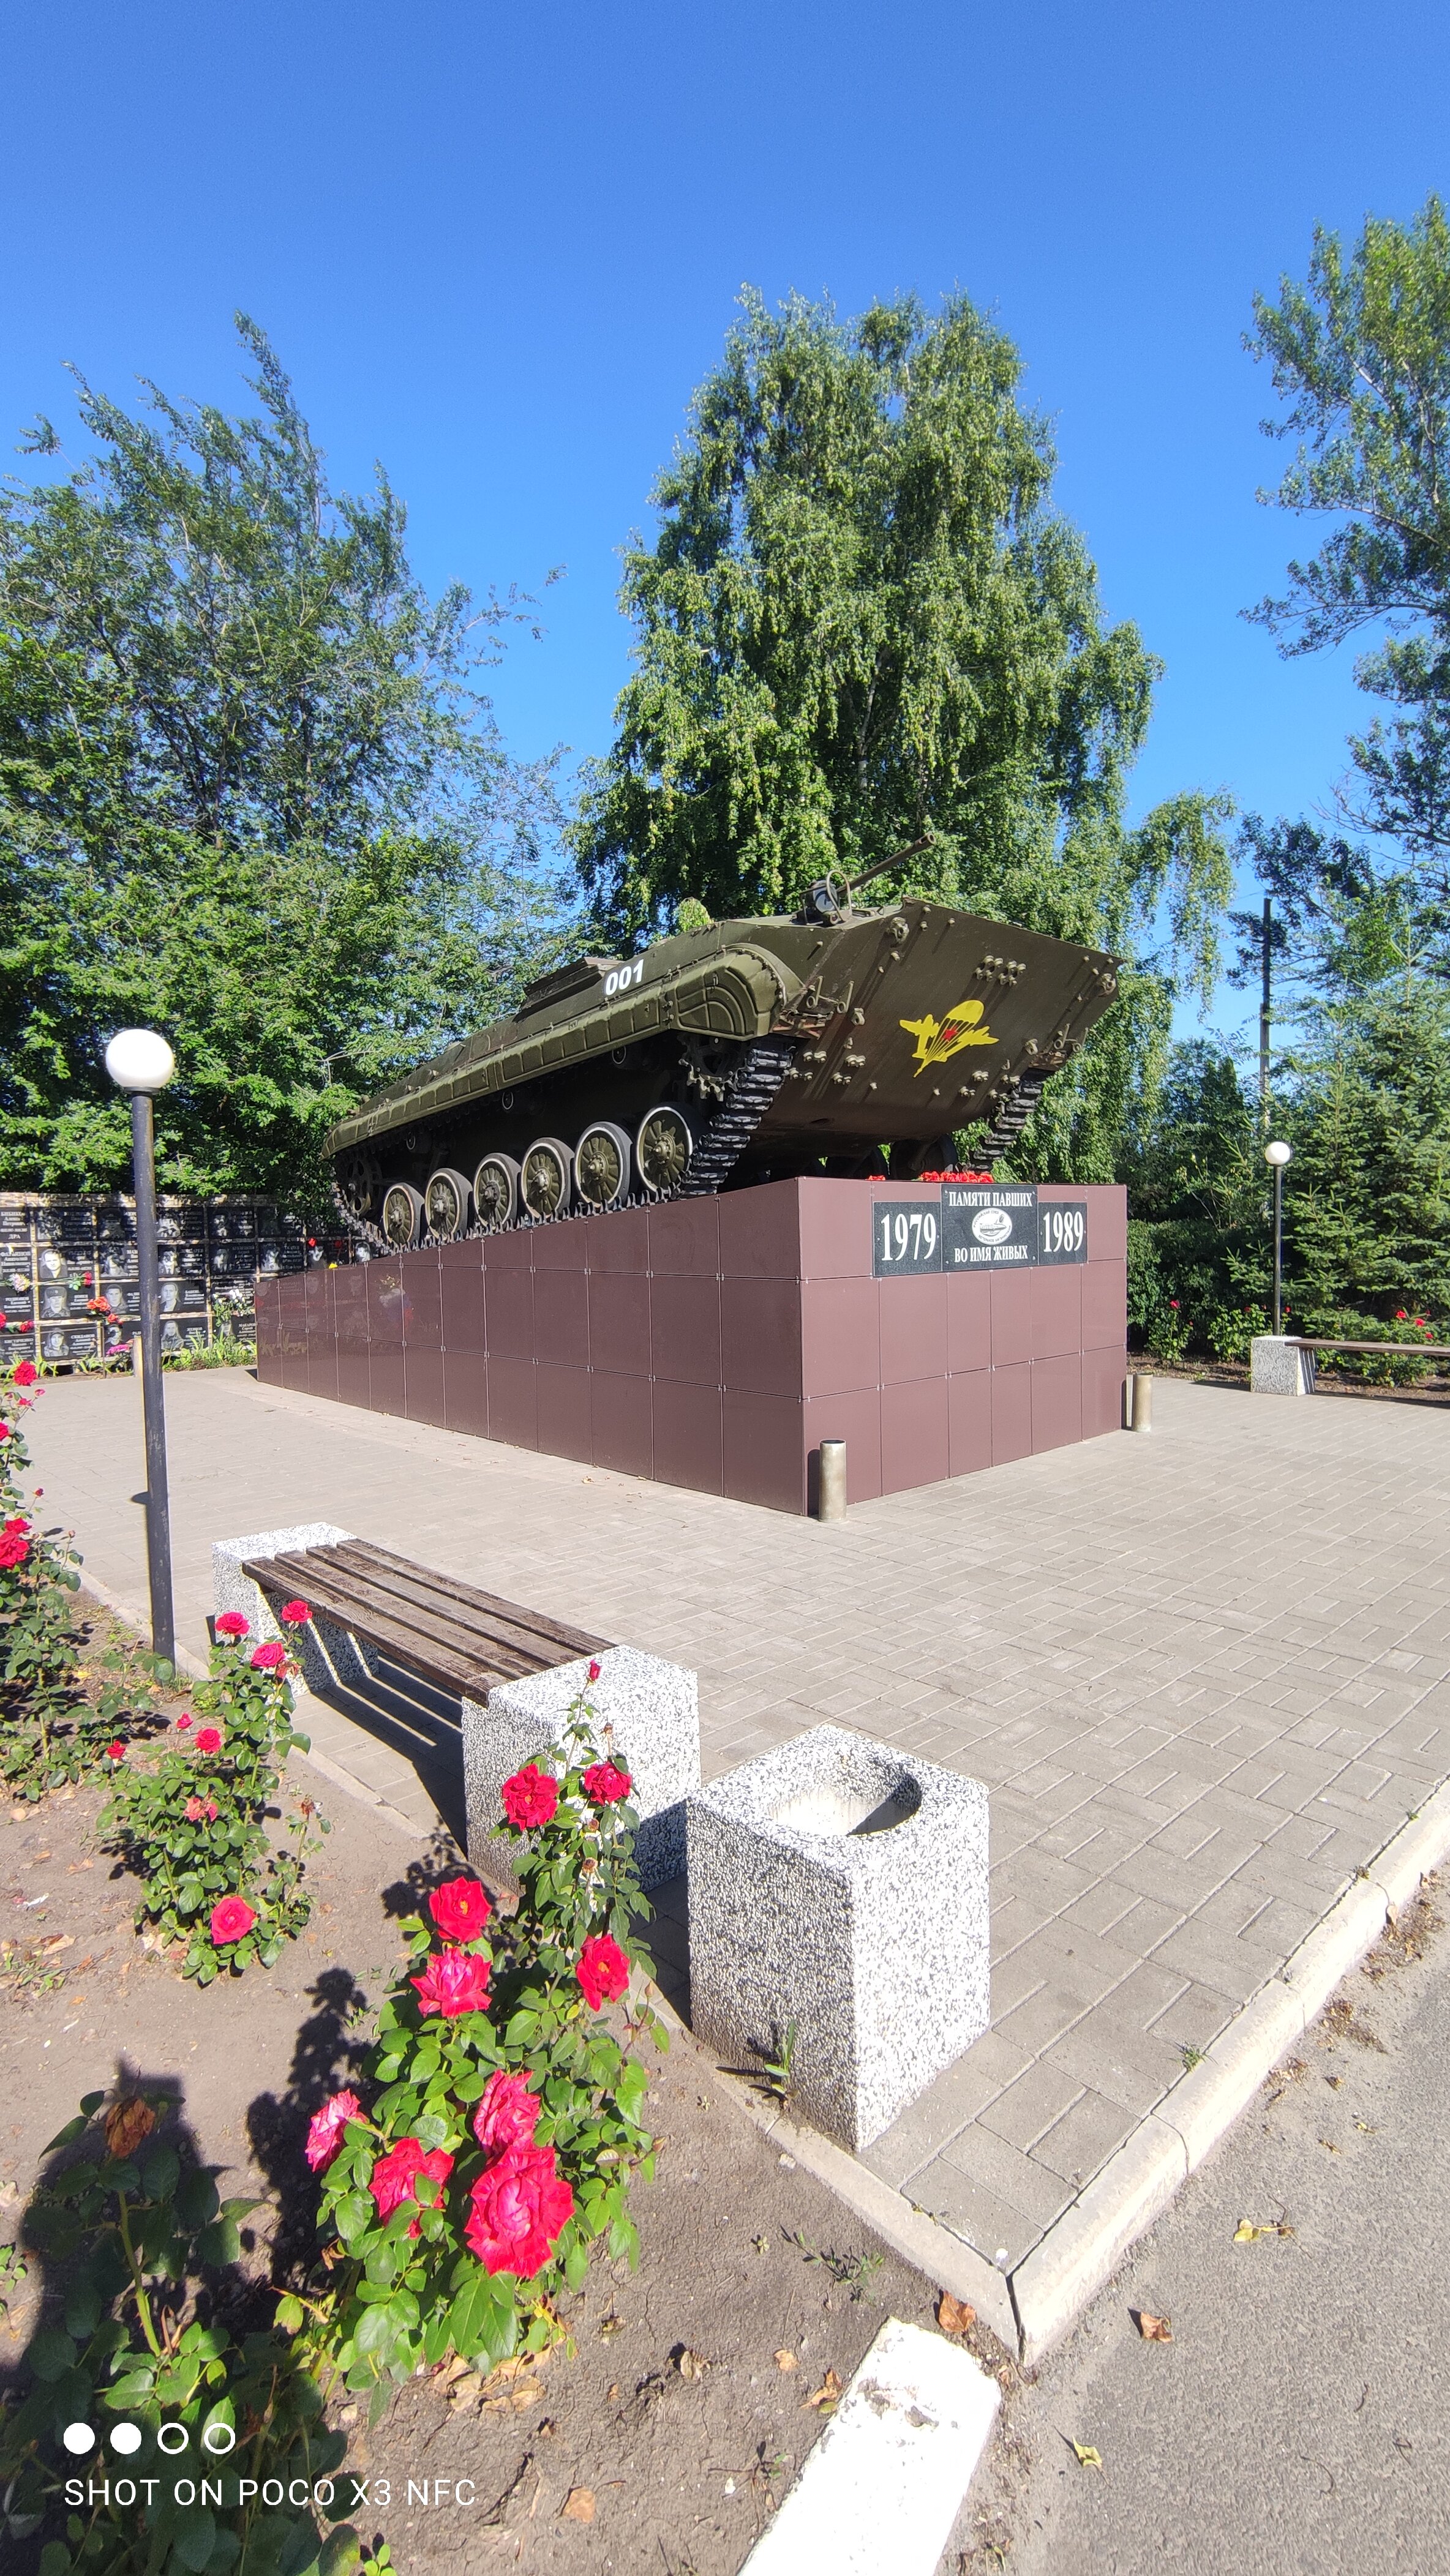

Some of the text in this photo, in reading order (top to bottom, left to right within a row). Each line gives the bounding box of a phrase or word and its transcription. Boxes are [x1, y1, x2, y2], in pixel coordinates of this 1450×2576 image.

[606, 959, 644, 996] 001
[949, 1191, 1032, 1207] ПАМЯТИ ПАВШИХ
[881, 1213, 937, 1261] 1979
[1043, 1211, 1084, 1252] 1989
[954, 1245, 1029, 1263] ВО ИМЯ ЖИВЫХ
